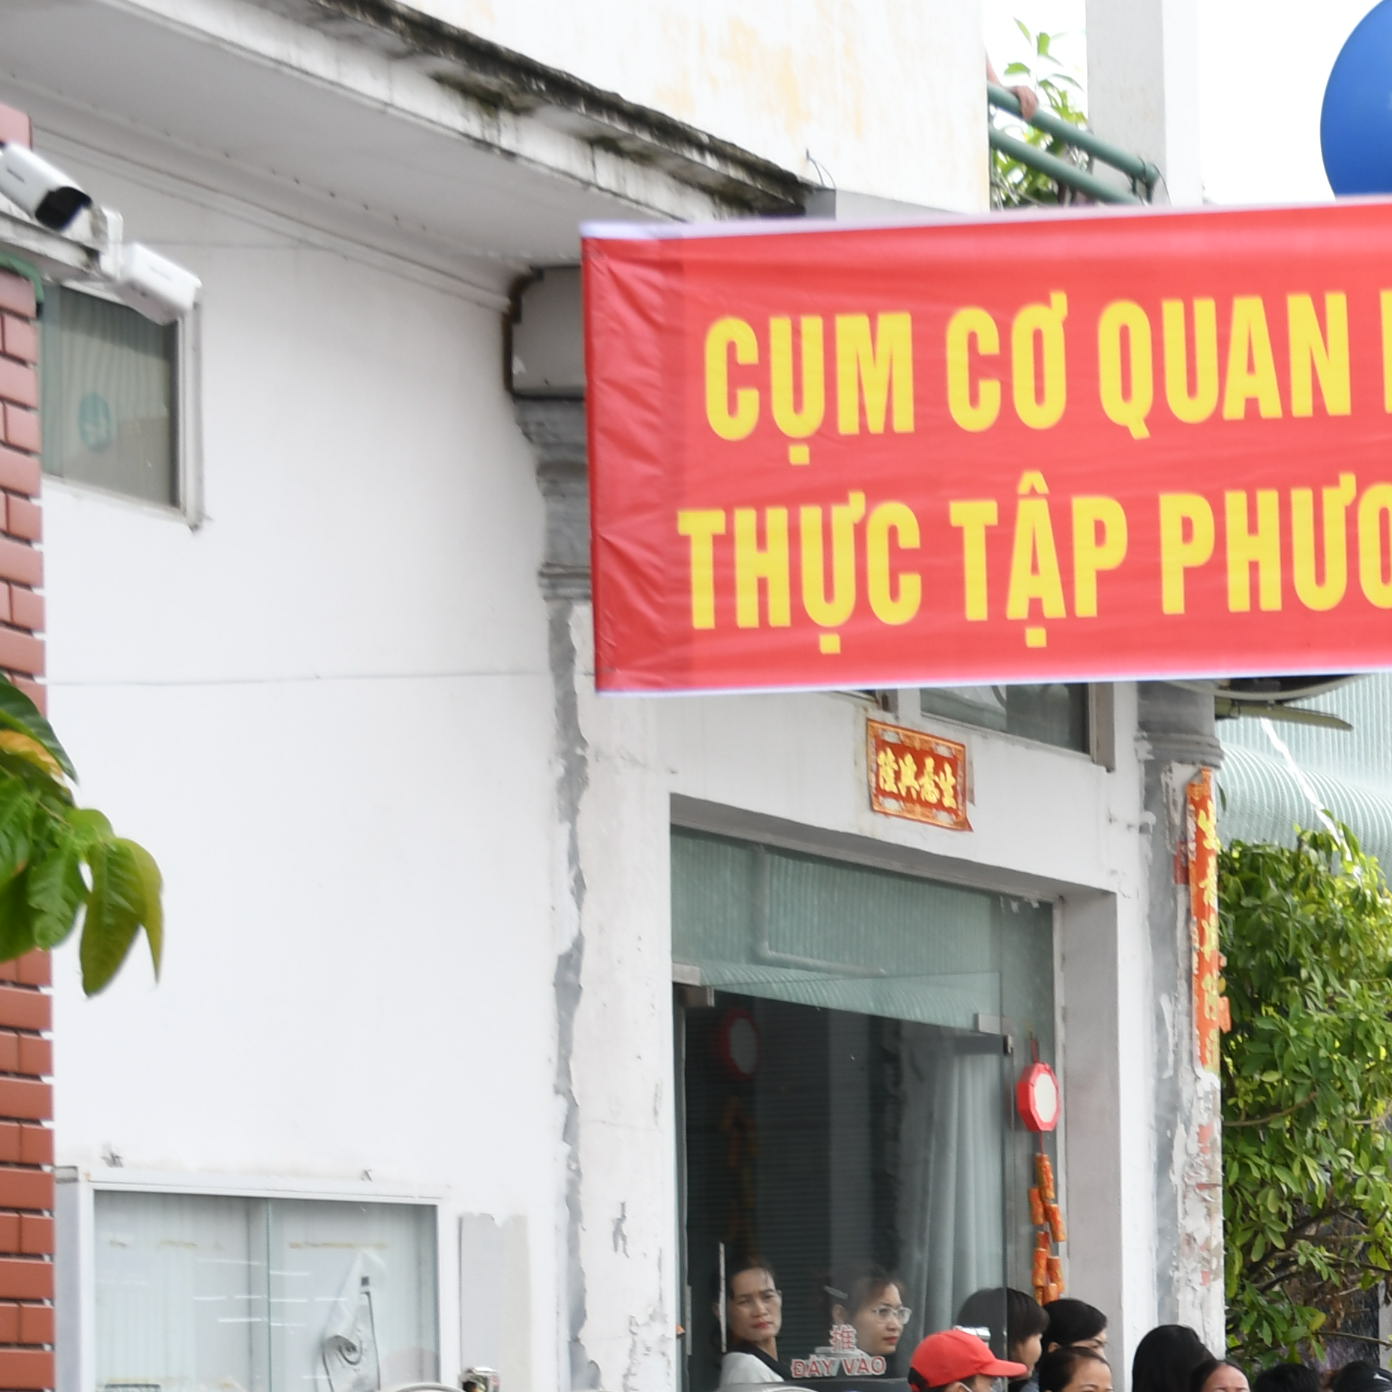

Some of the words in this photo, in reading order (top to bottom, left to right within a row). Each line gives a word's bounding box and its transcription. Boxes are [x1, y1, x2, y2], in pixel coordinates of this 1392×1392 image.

[707, 314, 912, 462] CỤM
[948, 294, 1066, 429] CƠ
[1100, 295, 1349, 437] QUAN
[680, 494, 920, 651] THỰC
[952, 474, 1126, 645] TẬP
